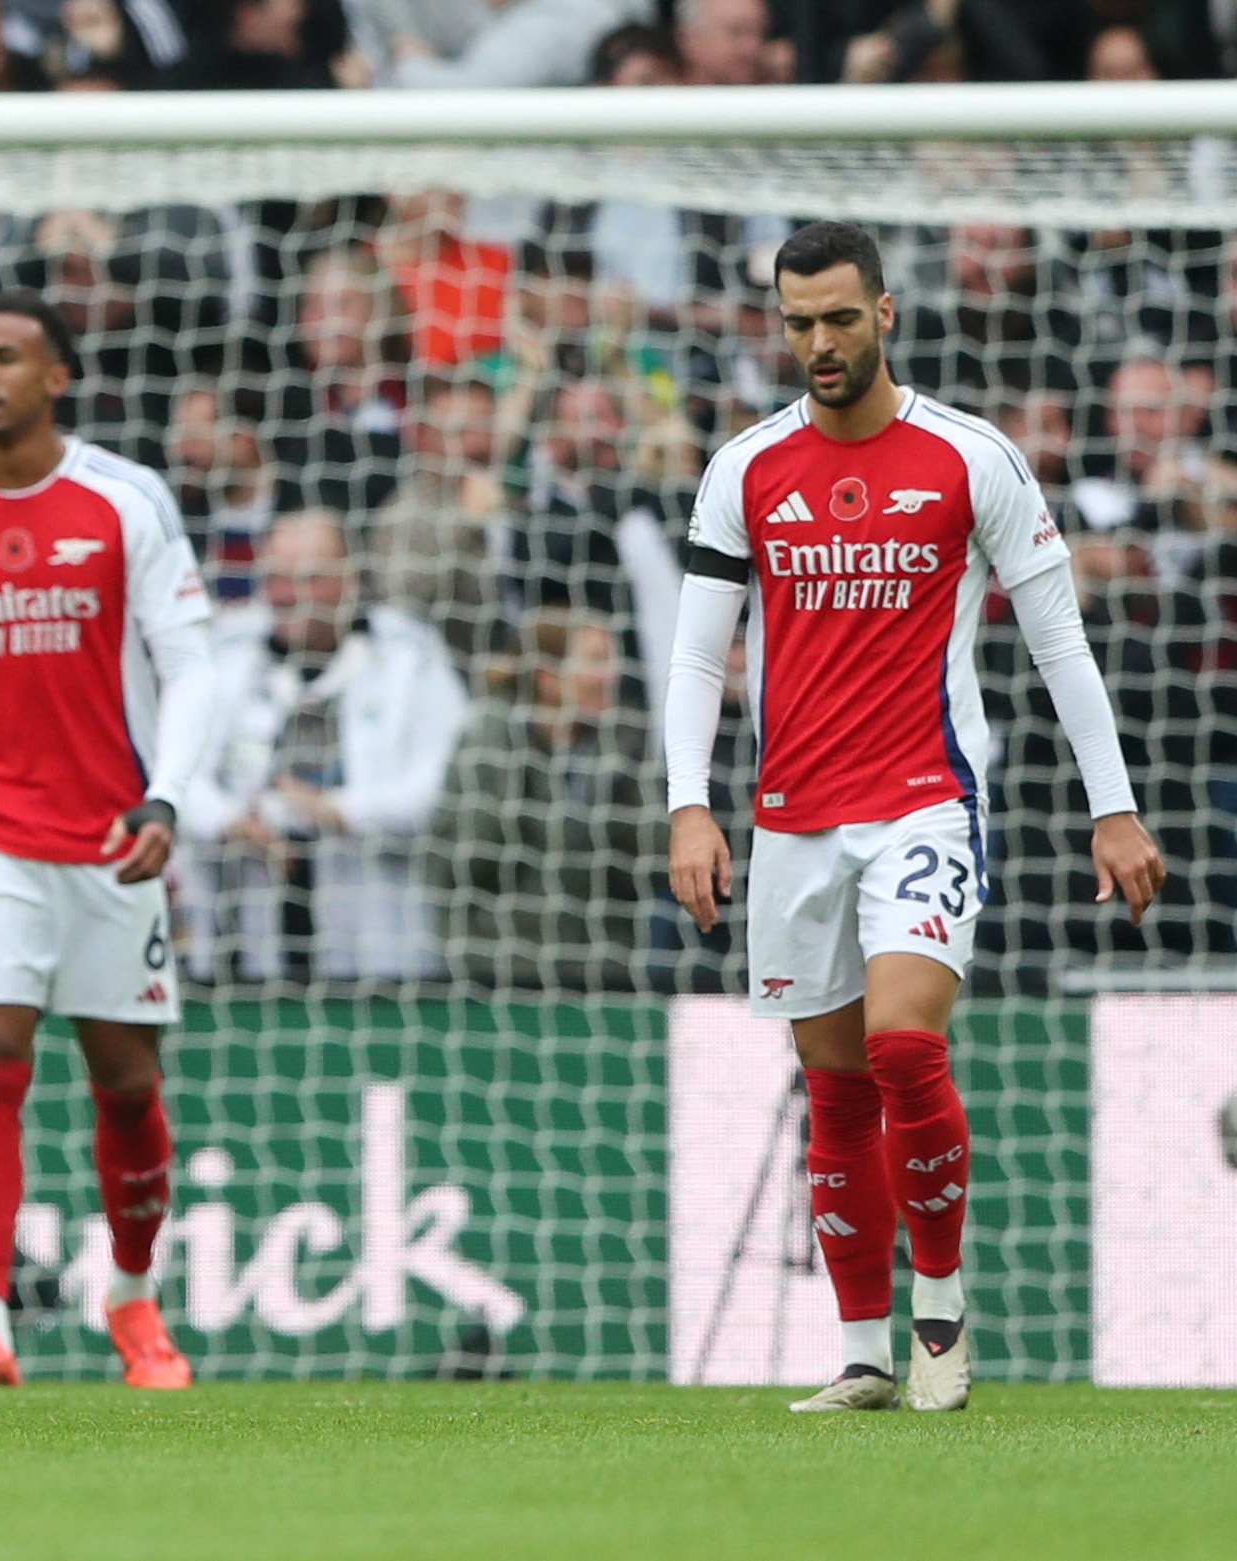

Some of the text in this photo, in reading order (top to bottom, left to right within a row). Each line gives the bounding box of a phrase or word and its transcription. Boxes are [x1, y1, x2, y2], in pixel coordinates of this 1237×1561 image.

[764, 534, 939, 576] Emirates
[795, 579, 911, 610] FLY BETTER
[895, 845, 969, 917] 23
[142, 913, 166, 971] 6
[906, 1144, 964, 1173] AFC
